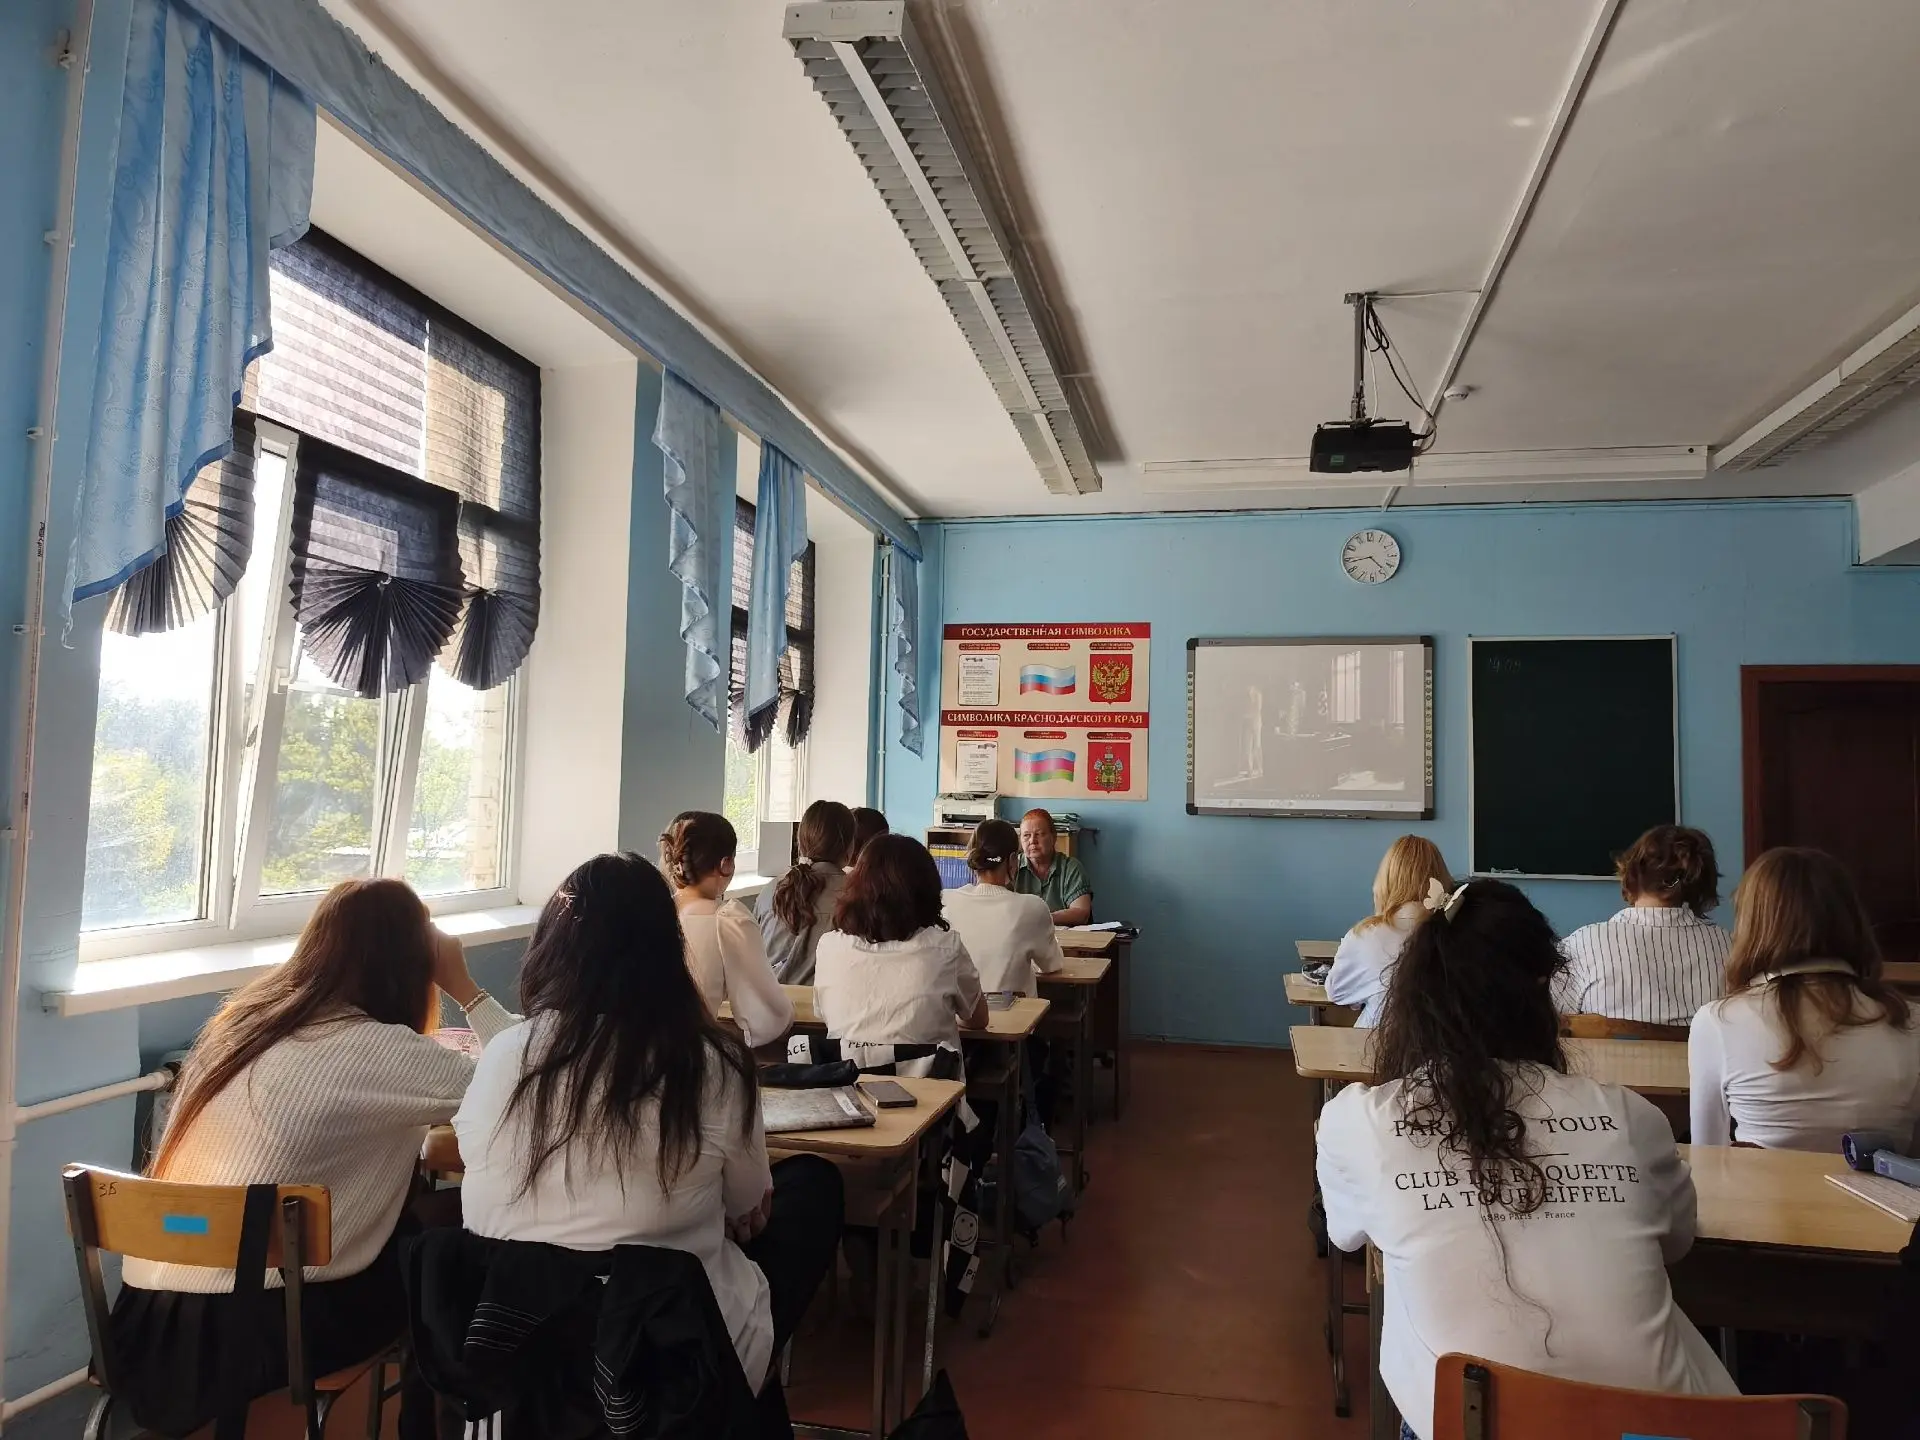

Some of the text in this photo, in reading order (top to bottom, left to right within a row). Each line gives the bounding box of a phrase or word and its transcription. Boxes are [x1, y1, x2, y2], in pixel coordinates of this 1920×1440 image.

[961, 627, 1131, 637] ГОСУДАРСТВЕННАЯ СИМВОЛИКА
[947, 713, 1143, 724] СИМВОЛИКА КРАСНОДАРСКОГО КРАЯ
[1540, 1115, 1619, 1134] TOUR
[1394, 1170, 1459, 1191] CLUB
[1509, 1164, 1640, 1184] RAQUETTE
[1422, 1186, 1626, 1211] LA TOUR EIFFEL
[1509, 1213, 1532, 1221] Paris
